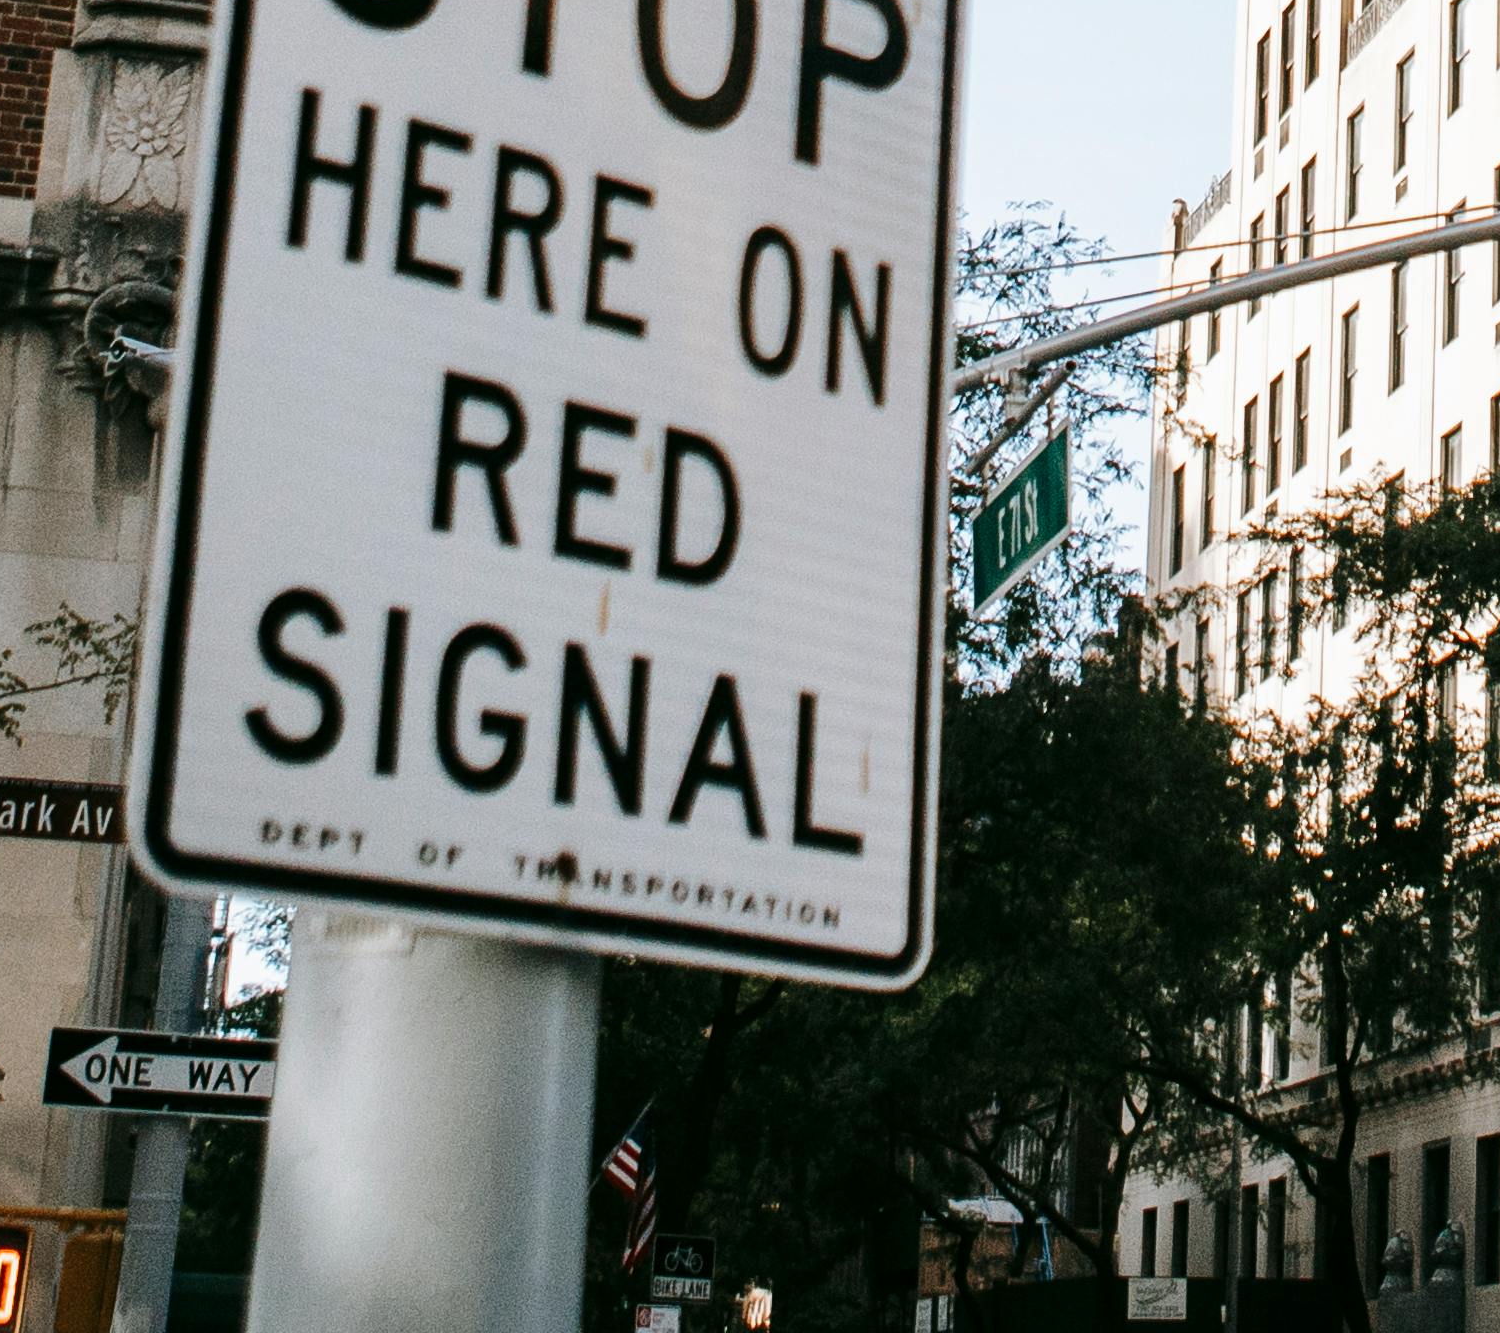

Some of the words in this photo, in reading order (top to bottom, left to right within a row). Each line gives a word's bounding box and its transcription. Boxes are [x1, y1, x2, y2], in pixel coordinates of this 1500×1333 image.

[286, 88, 655, 339] HERE
[737, 225, 892, 407] ON
[430, 371, 742, 588] RED
[244, 587, 865, 856] SIGNAL
[69, 799, 115, 837] Av
[261, 819, 365, 853] DEPT
[416, 840, 463, 870] OF
[84, 1052, 155, 1088] ONE
[187, 1062, 262, 1095] WAY
[654, 1277, 677, 1296] BIKE
[682, 1278, 709, 1299] LANE
